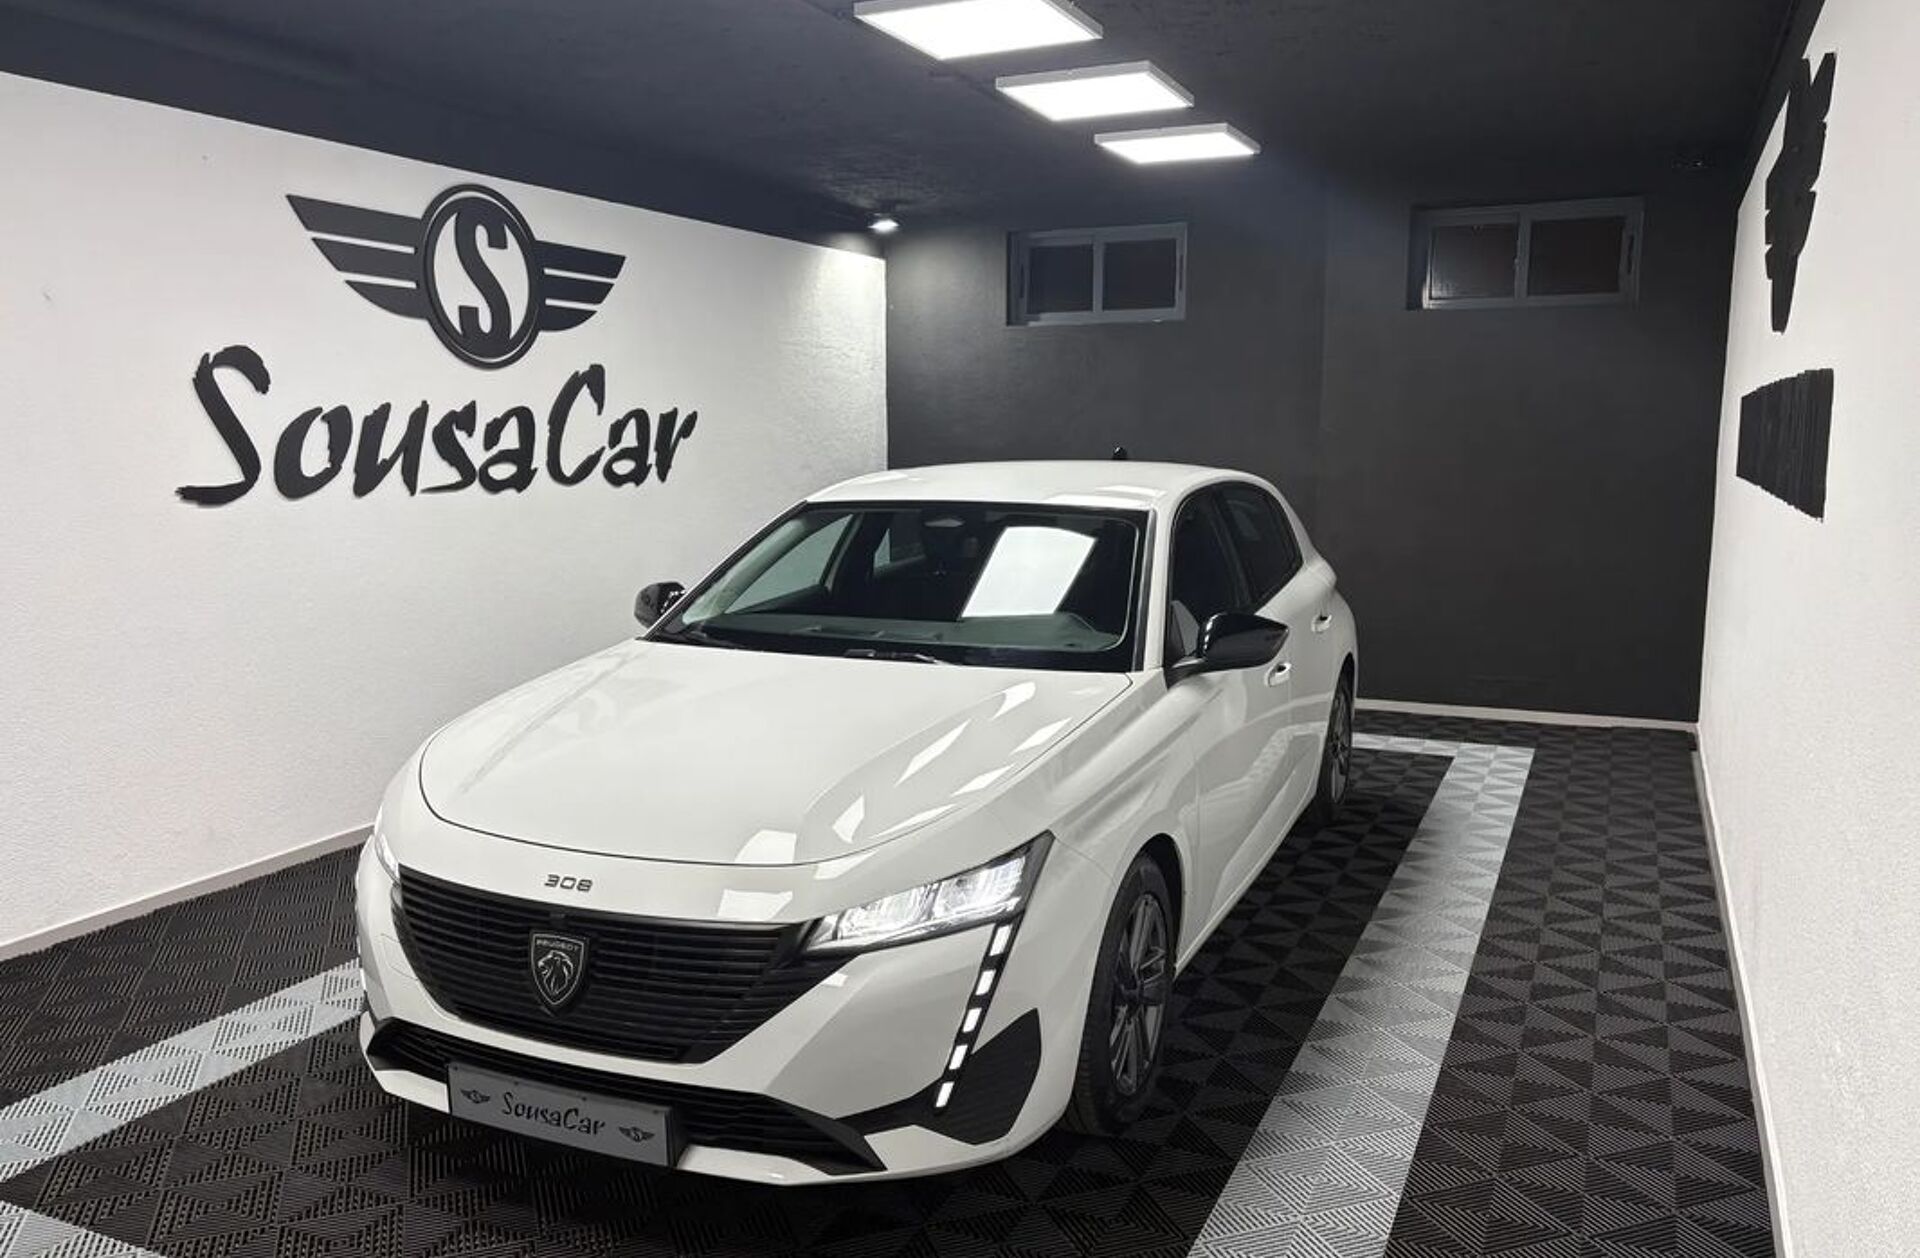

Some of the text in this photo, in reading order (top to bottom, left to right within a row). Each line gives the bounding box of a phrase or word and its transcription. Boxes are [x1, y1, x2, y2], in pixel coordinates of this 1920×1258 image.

[452, 197, 513, 358] S
[175, 344, 698, 507] SousaCar
[544, 873, 593, 892] 308
[502, 1091, 606, 1136] SousaCar
